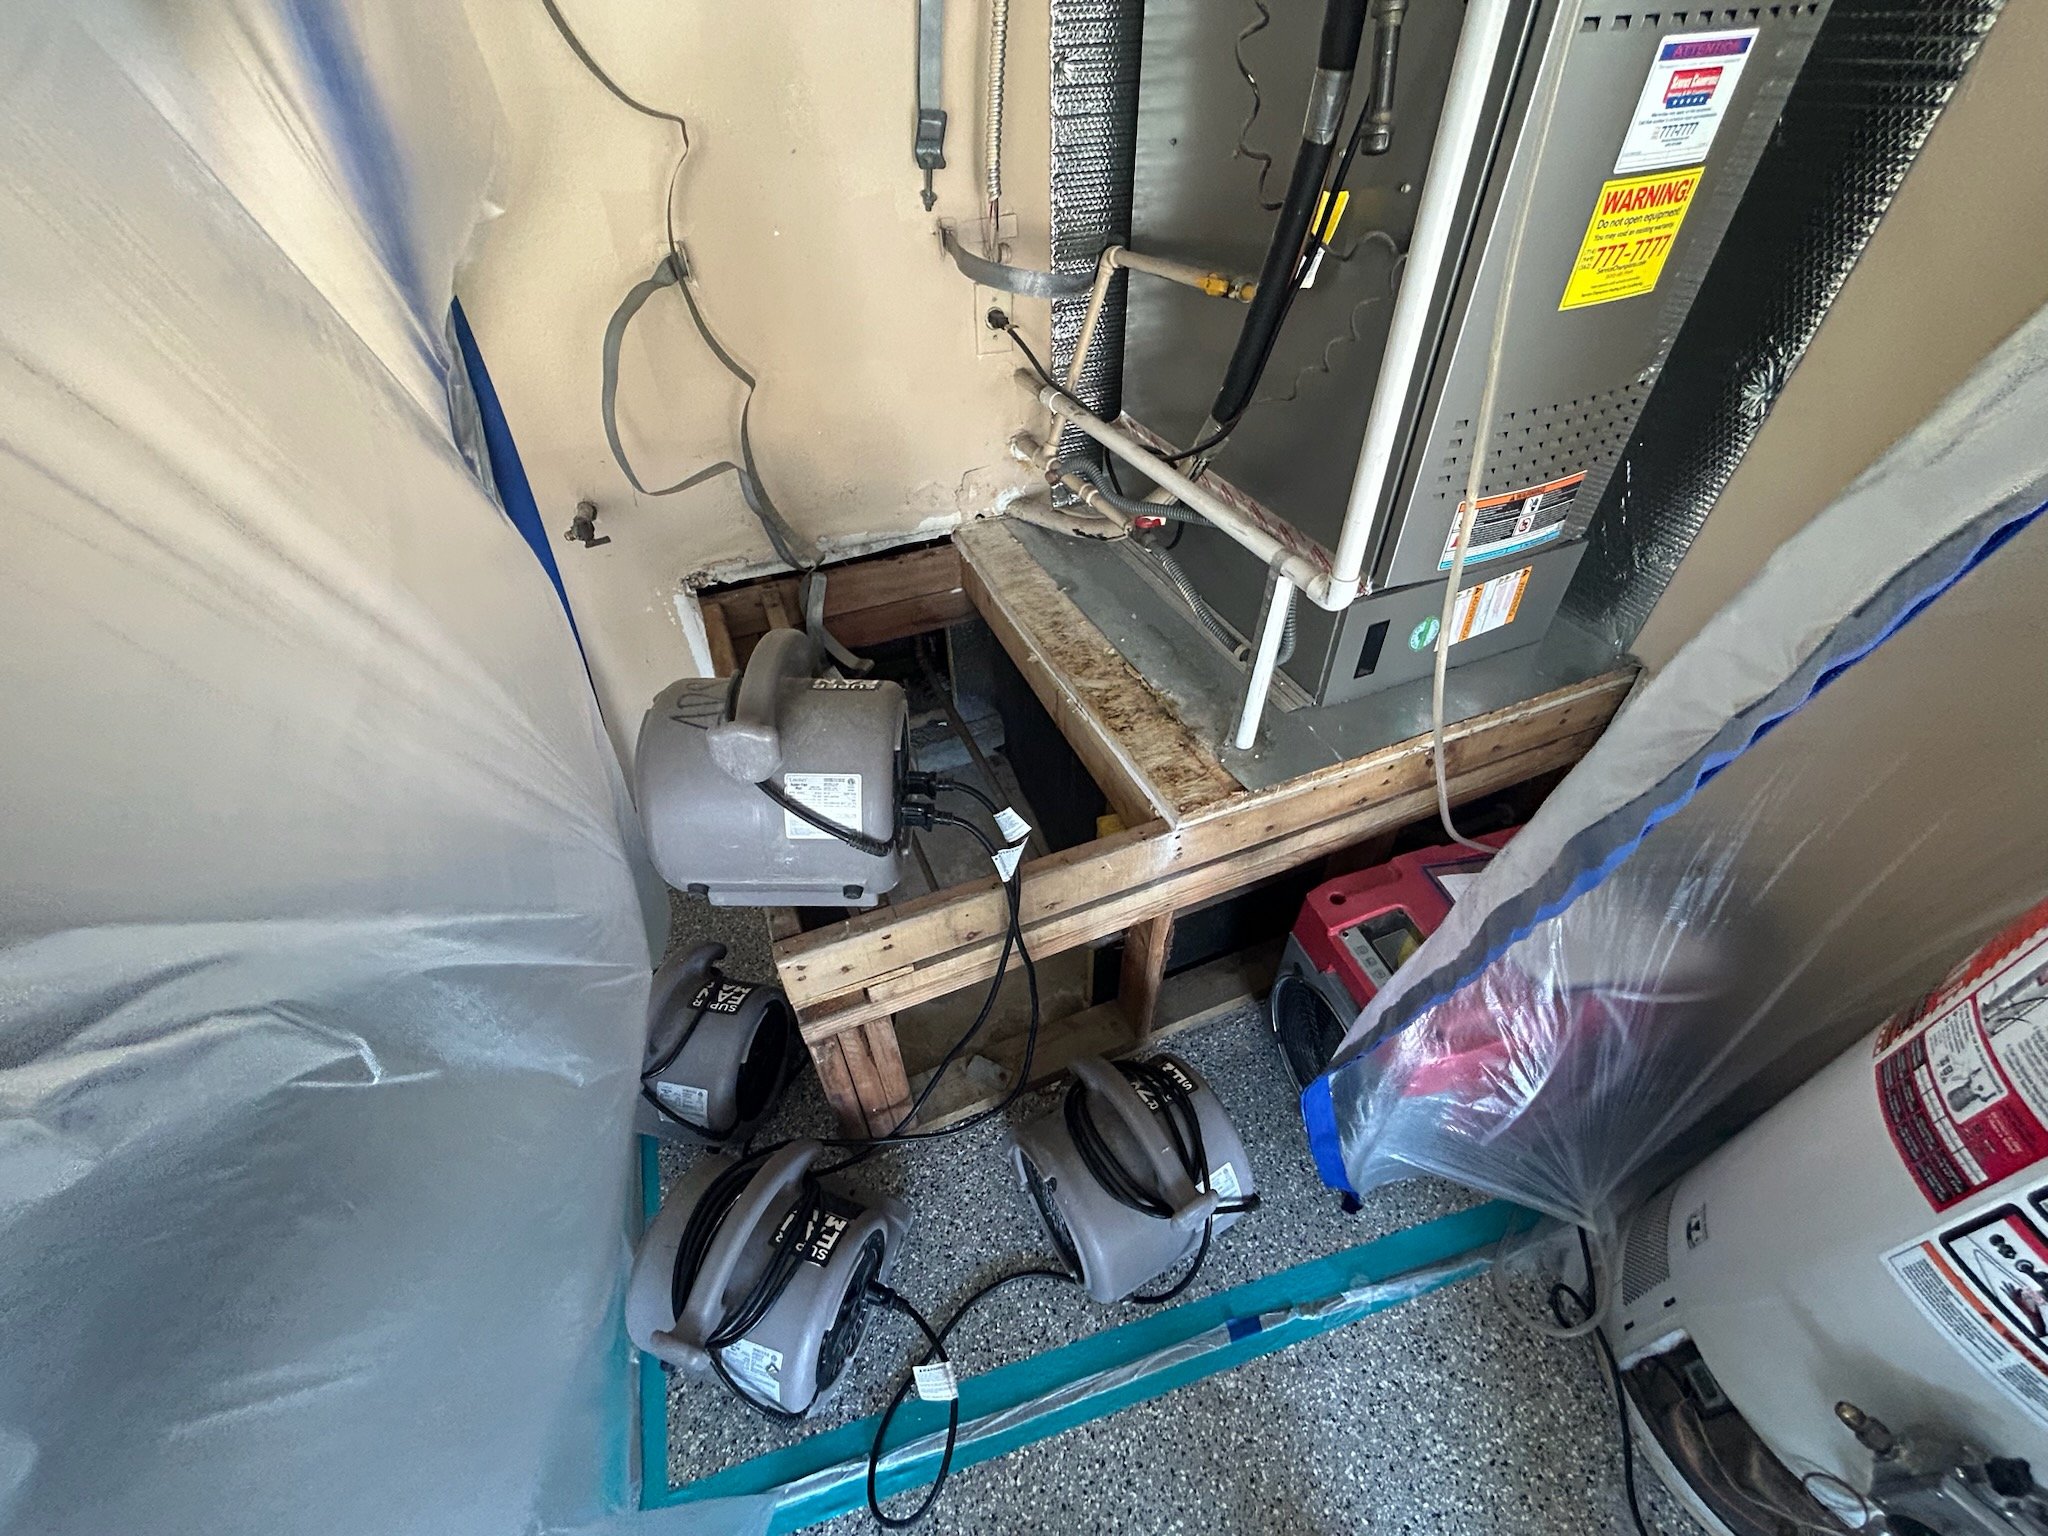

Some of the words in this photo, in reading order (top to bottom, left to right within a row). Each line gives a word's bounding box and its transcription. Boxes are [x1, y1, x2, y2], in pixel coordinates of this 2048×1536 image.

[1602, 178, 1695, 215] WARNING!
[1596, 219, 1609, 230] Do
[1609, 217, 1624, 228] not
[1624, 215, 1643, 227] open
[1592, 233, 1673, 270] 777-7777
